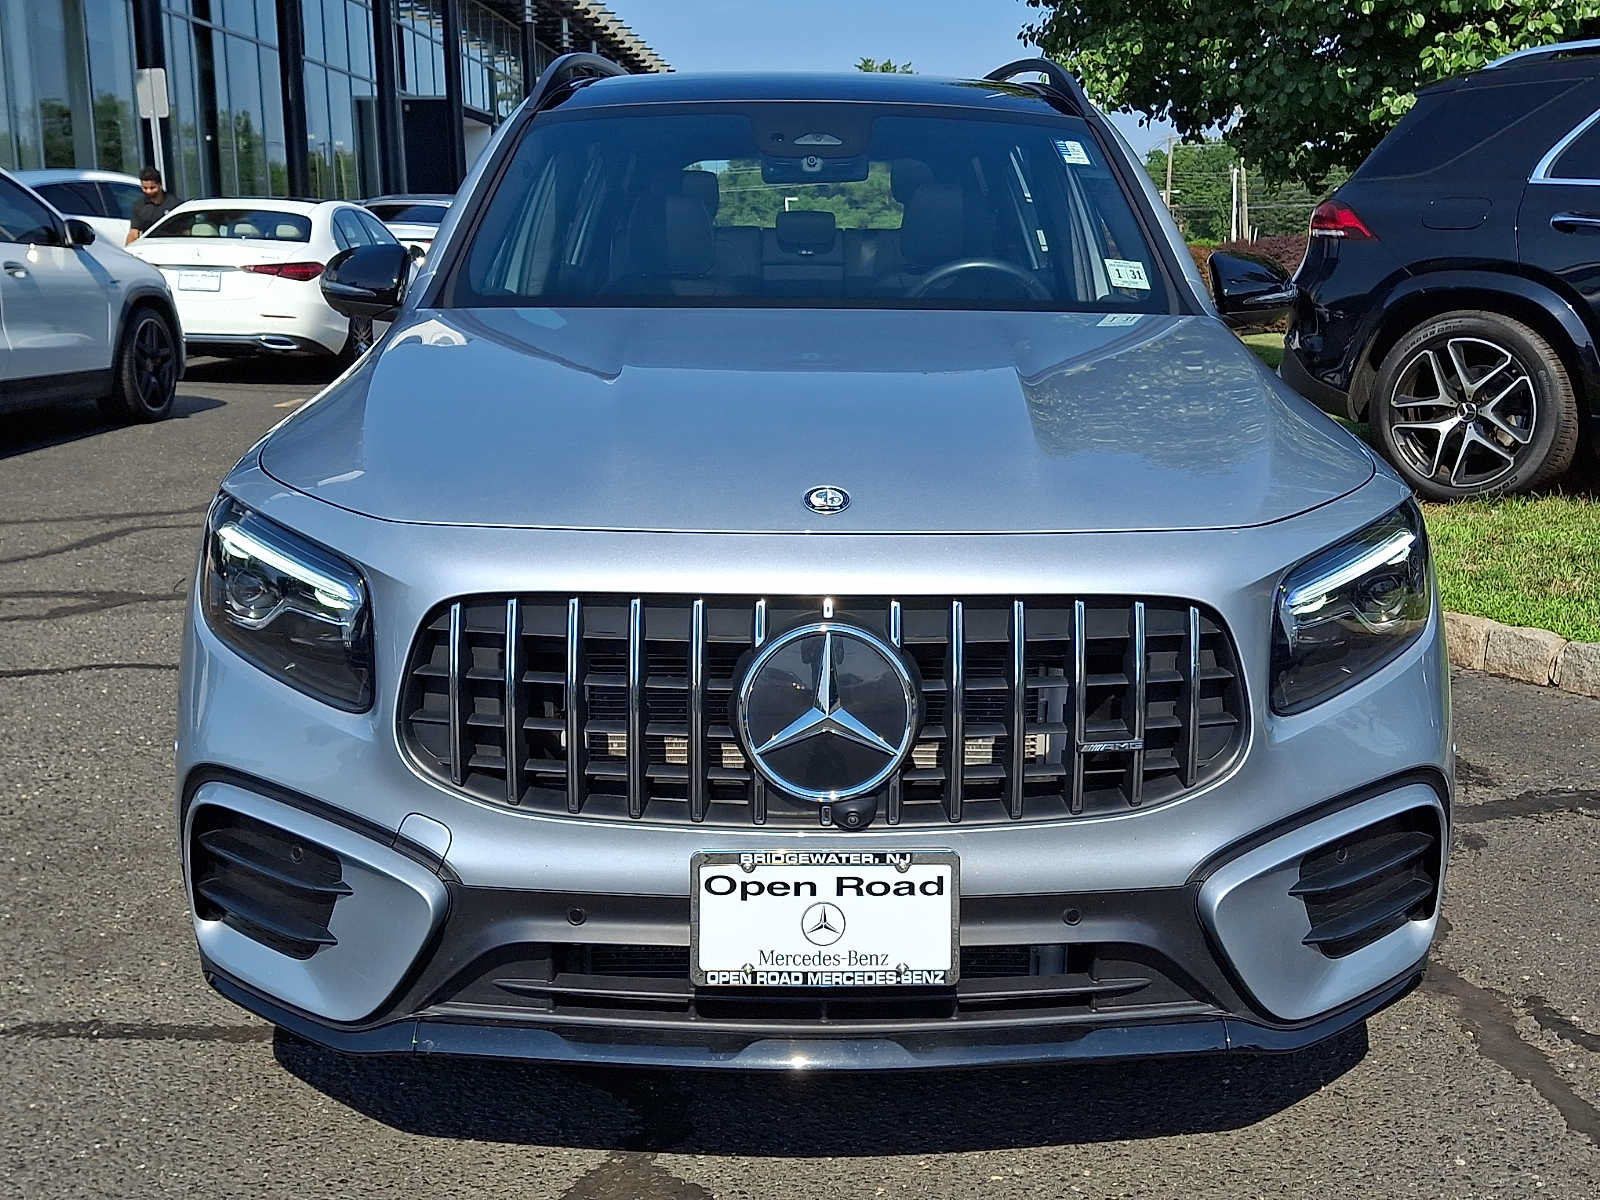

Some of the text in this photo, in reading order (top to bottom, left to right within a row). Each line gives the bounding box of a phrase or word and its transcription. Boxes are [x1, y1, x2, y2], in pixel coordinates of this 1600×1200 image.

[1115, 268, 1144, 281] 1 31
[1097, 742, 1144, 752] AMG
[740, 853, 911, 864] BRIDGEWATER, NJ
[704, 875, 944, 901] Open Road
[758, 950, 889, 967] Mercedes-Benz
[706, 971, 945, 985] OPEN ROAD MERCEDES-BENZ
